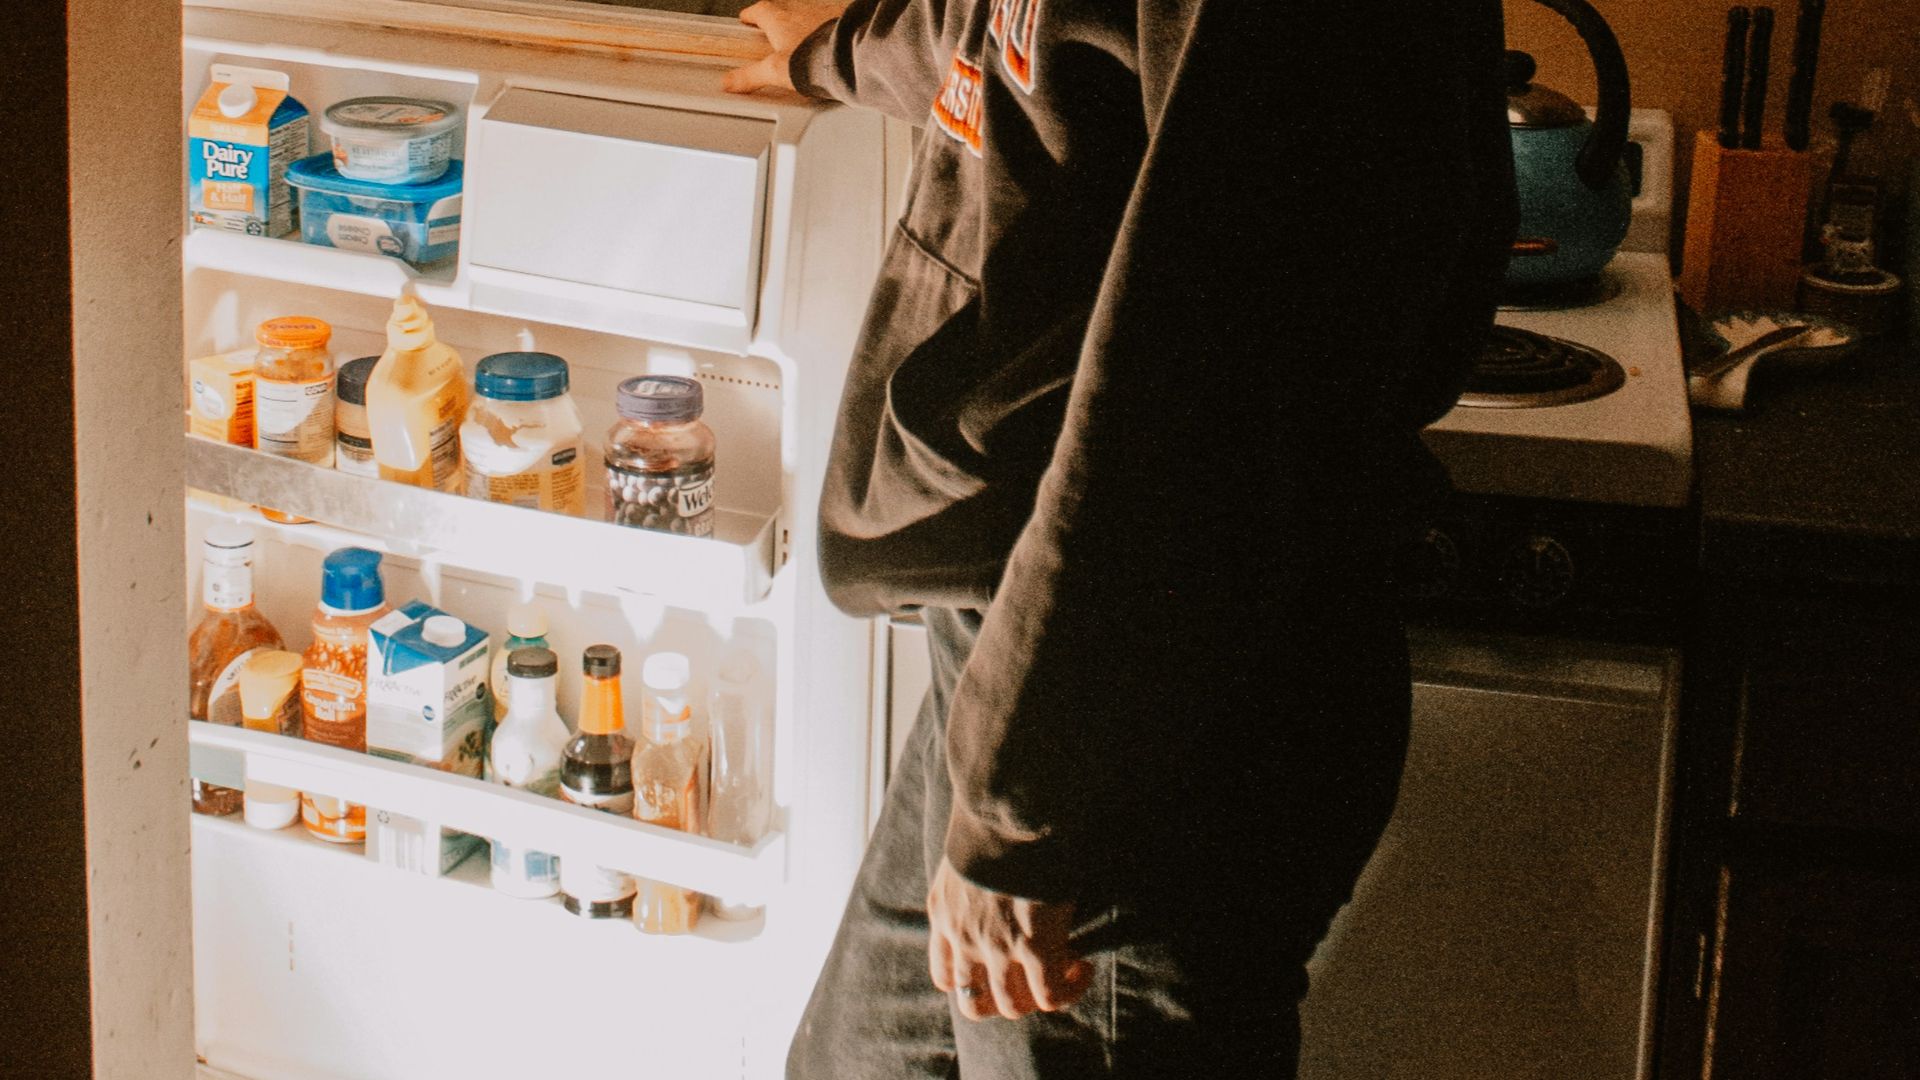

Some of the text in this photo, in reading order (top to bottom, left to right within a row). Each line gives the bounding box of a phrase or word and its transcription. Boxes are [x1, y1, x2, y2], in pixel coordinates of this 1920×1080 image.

[202, 140, 253, 166] Dairy
[206, 159, 248, 179] Pure
[223, 192, 247, 203] Half
